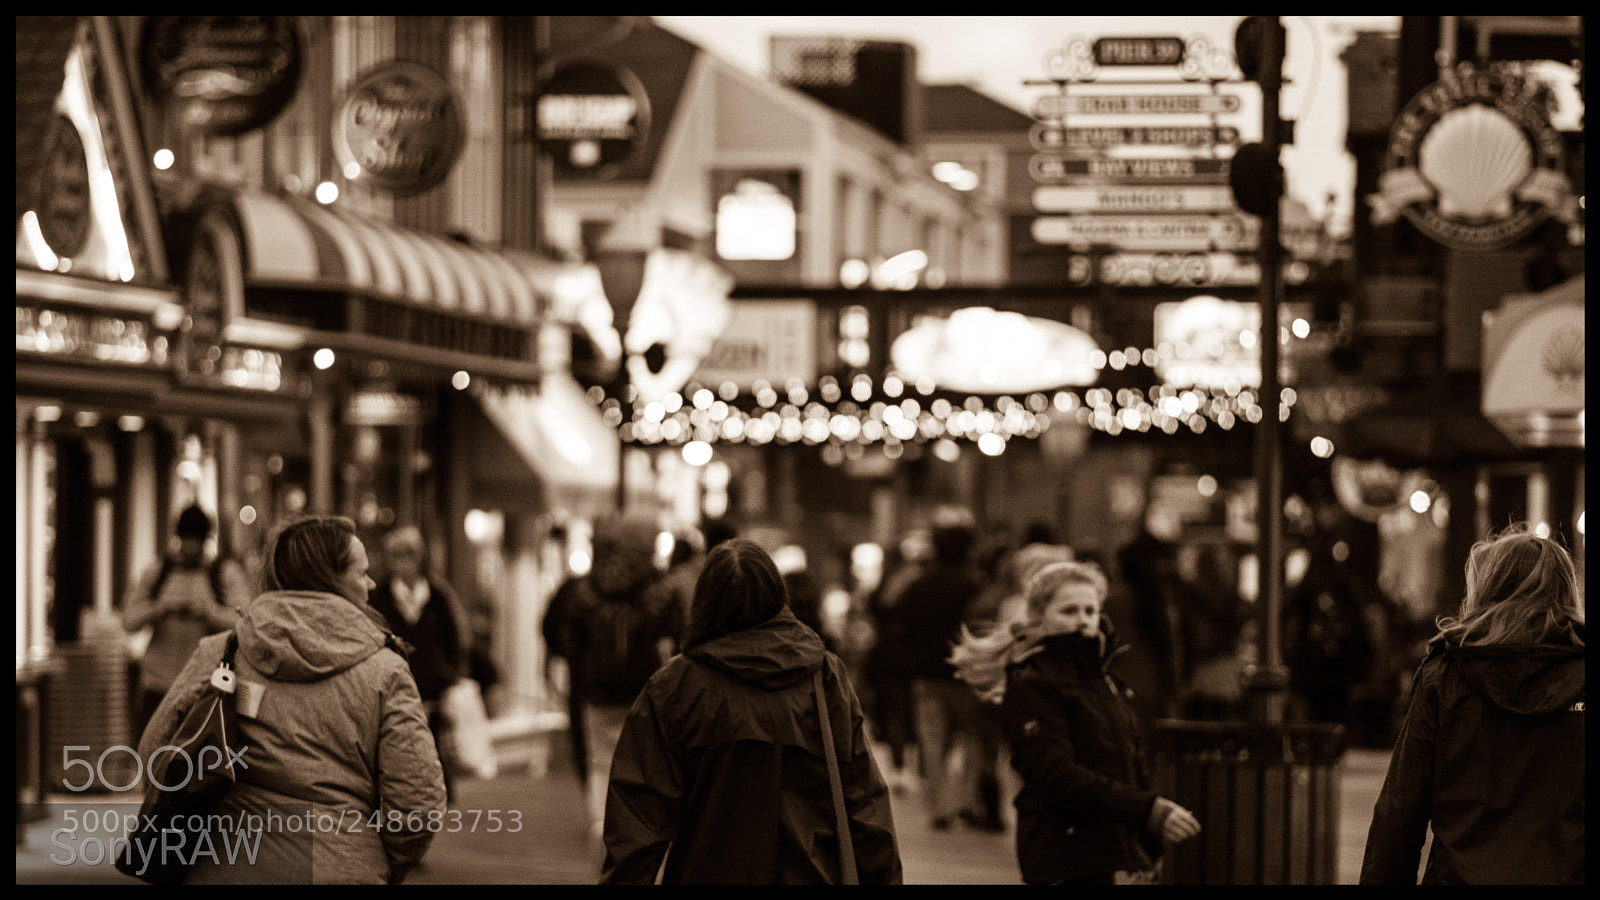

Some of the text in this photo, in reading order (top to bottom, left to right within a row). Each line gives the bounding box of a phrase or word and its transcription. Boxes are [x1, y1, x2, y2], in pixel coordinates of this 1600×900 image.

[1101, 42, 1153, 62] PIER
[1078, 96, 1200, 112] CRAB HOUSE
[1131, 160, 1194, 177] VIEWS
